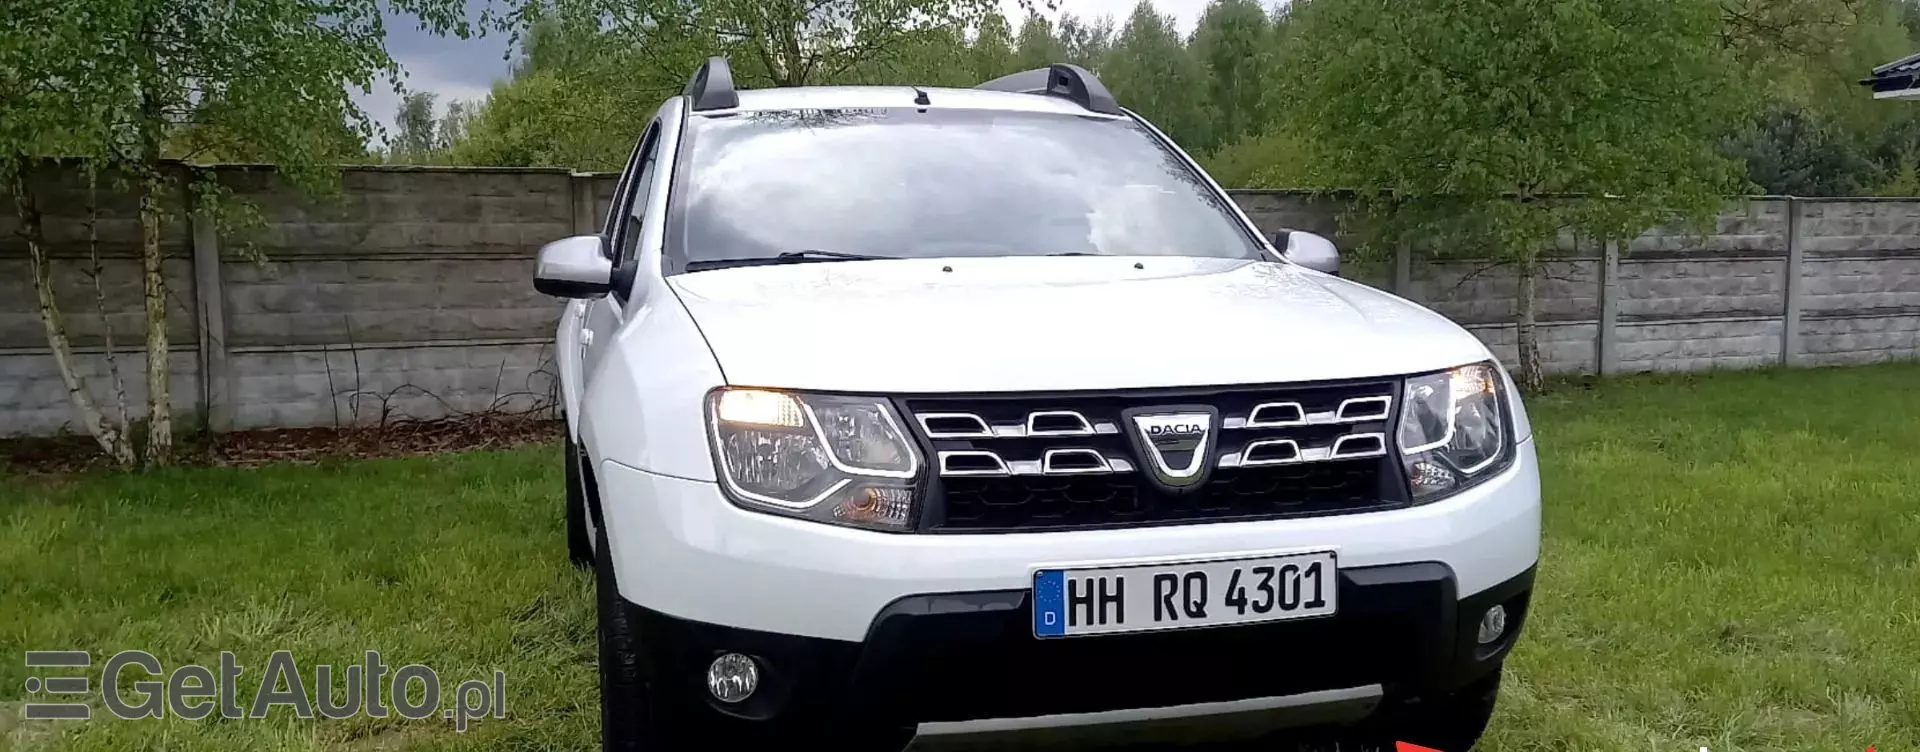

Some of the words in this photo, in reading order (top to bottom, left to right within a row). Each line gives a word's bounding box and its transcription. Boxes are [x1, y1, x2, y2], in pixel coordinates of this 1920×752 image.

[1150, 424, 1202, 434] DACIA
[1068, 576, 1124, 626] HH
[1153, 571, 1207, 621] RQ
[1225, 561, 1326, 615] 4301
[1044, 611, 1056, 625] D
